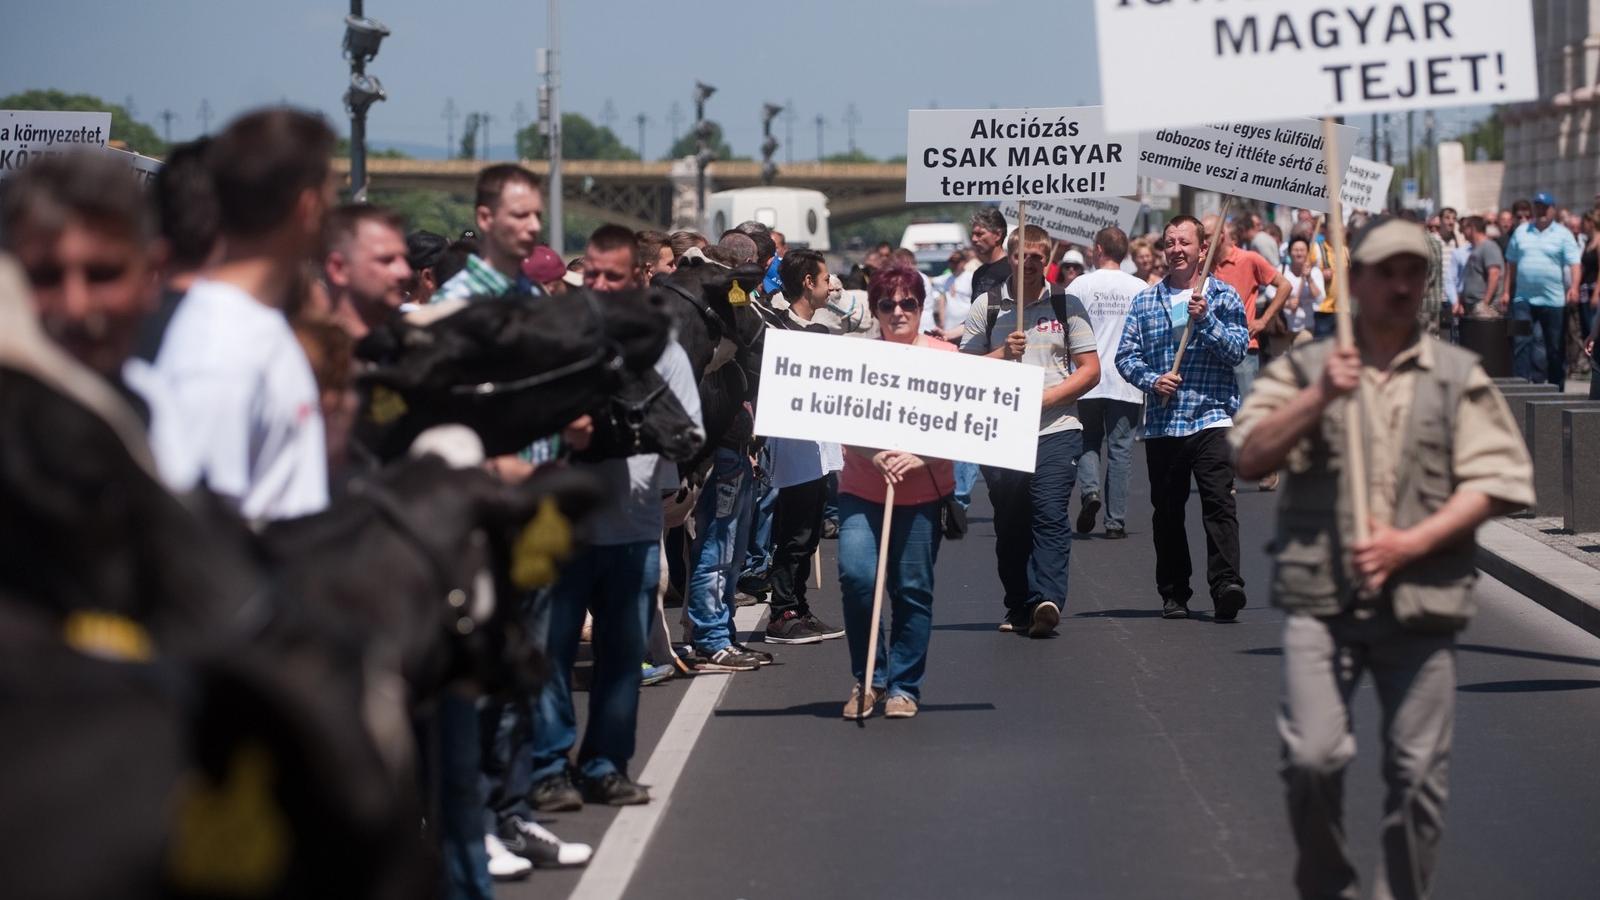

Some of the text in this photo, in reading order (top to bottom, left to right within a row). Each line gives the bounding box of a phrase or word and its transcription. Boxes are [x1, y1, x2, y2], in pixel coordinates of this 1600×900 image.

[1214, 2, 1453, 55] MAGYAR
[1322, 53, 1507, 102] TEJET!
[14, 124, 105, 147] környezetet,
[970, 116, 1079, 139] Akciózás
[1233, 123, 1271, 139] egyes
[1274, 127, 1326, 151] külföldi
[923, 143, 1123, 168] CSAK MAGYAR
[1156, 128, 1211, 151] dobozos
[1214, 139, 1234, 158] tej
[1235, 143, 1276, 165] ittléte
[1278, 154, 1314, 172] sértő
[1139, 150, 1202, 173] semmibe
[1206, 164, 1239, 181] veszi
[1240, 172, 1249, 183] a
[941, 171, 1106, 196] termékekkel!
[1004, 206, 1044, 227] tízzreit
[1024, 200, 1120, 229] agyar munkahelyek
[774, 356, 1021, 412] Ha nem lesz magyar tej
[790, 392, 999, 441] a külföldi téged fej!
